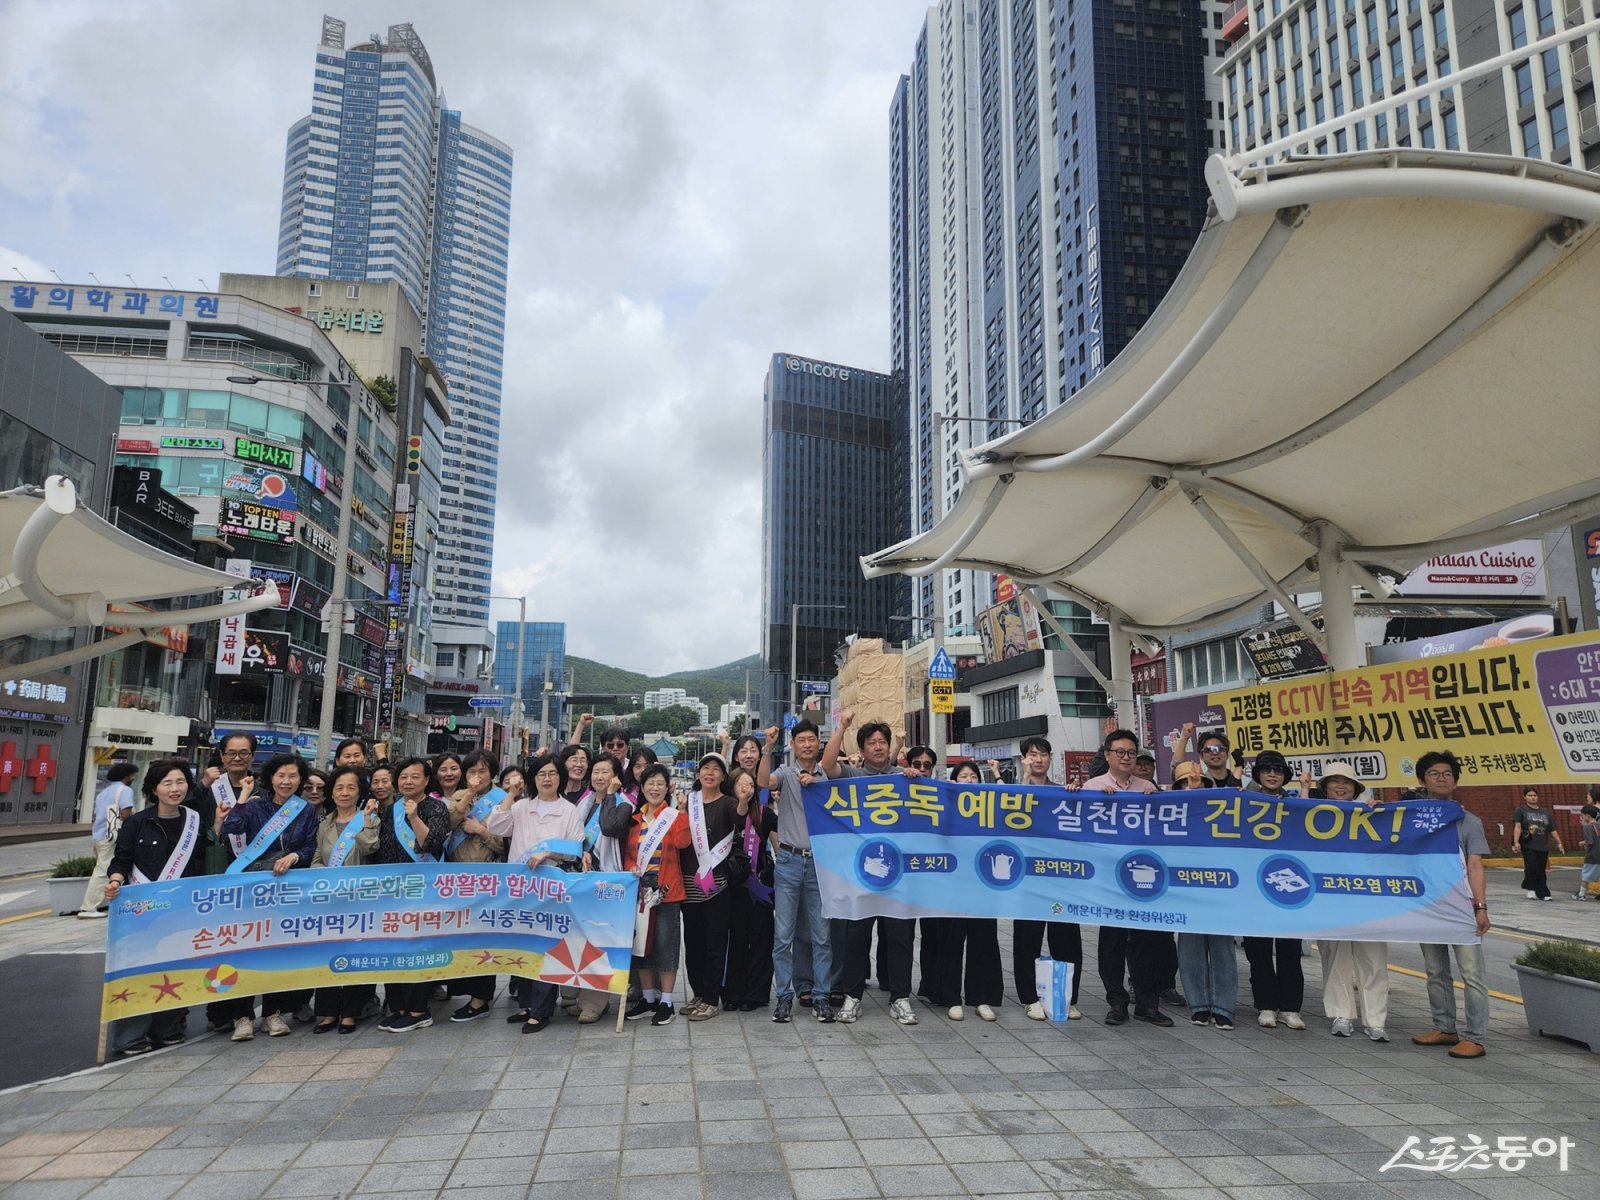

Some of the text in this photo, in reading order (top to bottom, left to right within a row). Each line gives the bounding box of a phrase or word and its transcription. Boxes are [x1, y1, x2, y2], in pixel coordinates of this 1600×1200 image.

[10, 285, 219, 319] 활의학과의원
[787, 357, 849, 381] encore
[945, 351, 955, 376] 201
[237, 439, 293, 468] 발마사지
[136, 471, 150, 504] BAR
[228, 501, 240, 510] 10
[244, 505, 260, 514] TOP
[262, 509, 279, 518] TEN
[226, 510, 291, 535] 노래타운
[1480, 551, 1537, 568] Cuisine
[1431, 575, 1469, 583] Naan&Curry
[221, 618, 239, 666] 낙곱새
[242, 644, 264, 668] 우
[1230, 690, 1273, 722] 고정형
[1277, 684, 1325, 717] CCTV
[1330, 675, 1373, 711] 단속
[1380, 654, 1531, 704] 지역입니다.
[1237, 699, 1535, 752] 이동 주차하여 주시기 바랍니다.
[1568, 709, 1598, 725] 어린이
[120, 734, 154, 746] SIGNATURE
[256, 735, 274, 745] S25
[1307, 758, 1322, 776] 7월
[1456, 751, 1547, 774] 구청 주차행정과
[823, 783, 1406, 842] 식중독 예방 실천하면 건강 OK!
[909, 856, 948, 870] 손 씻기
[1034, 859, 1086, 876] 끓여먹기
[1177, 870, 1232, 886] 익혀먹기
[1322, 876, 1418, 895] 교차오염 방지
[192, 872, 571, 914] 낭비 없는 음식문화를 생활화 합시다.
[1067, 902, 1188, 926] 해운대구청 환경위생과
[192, 908, 572, 950] 손씻기! 익혀먹기! 끓여먹기! 식중독예방
[350, 952, 449, 968] 해운대구 (환경위생과)
